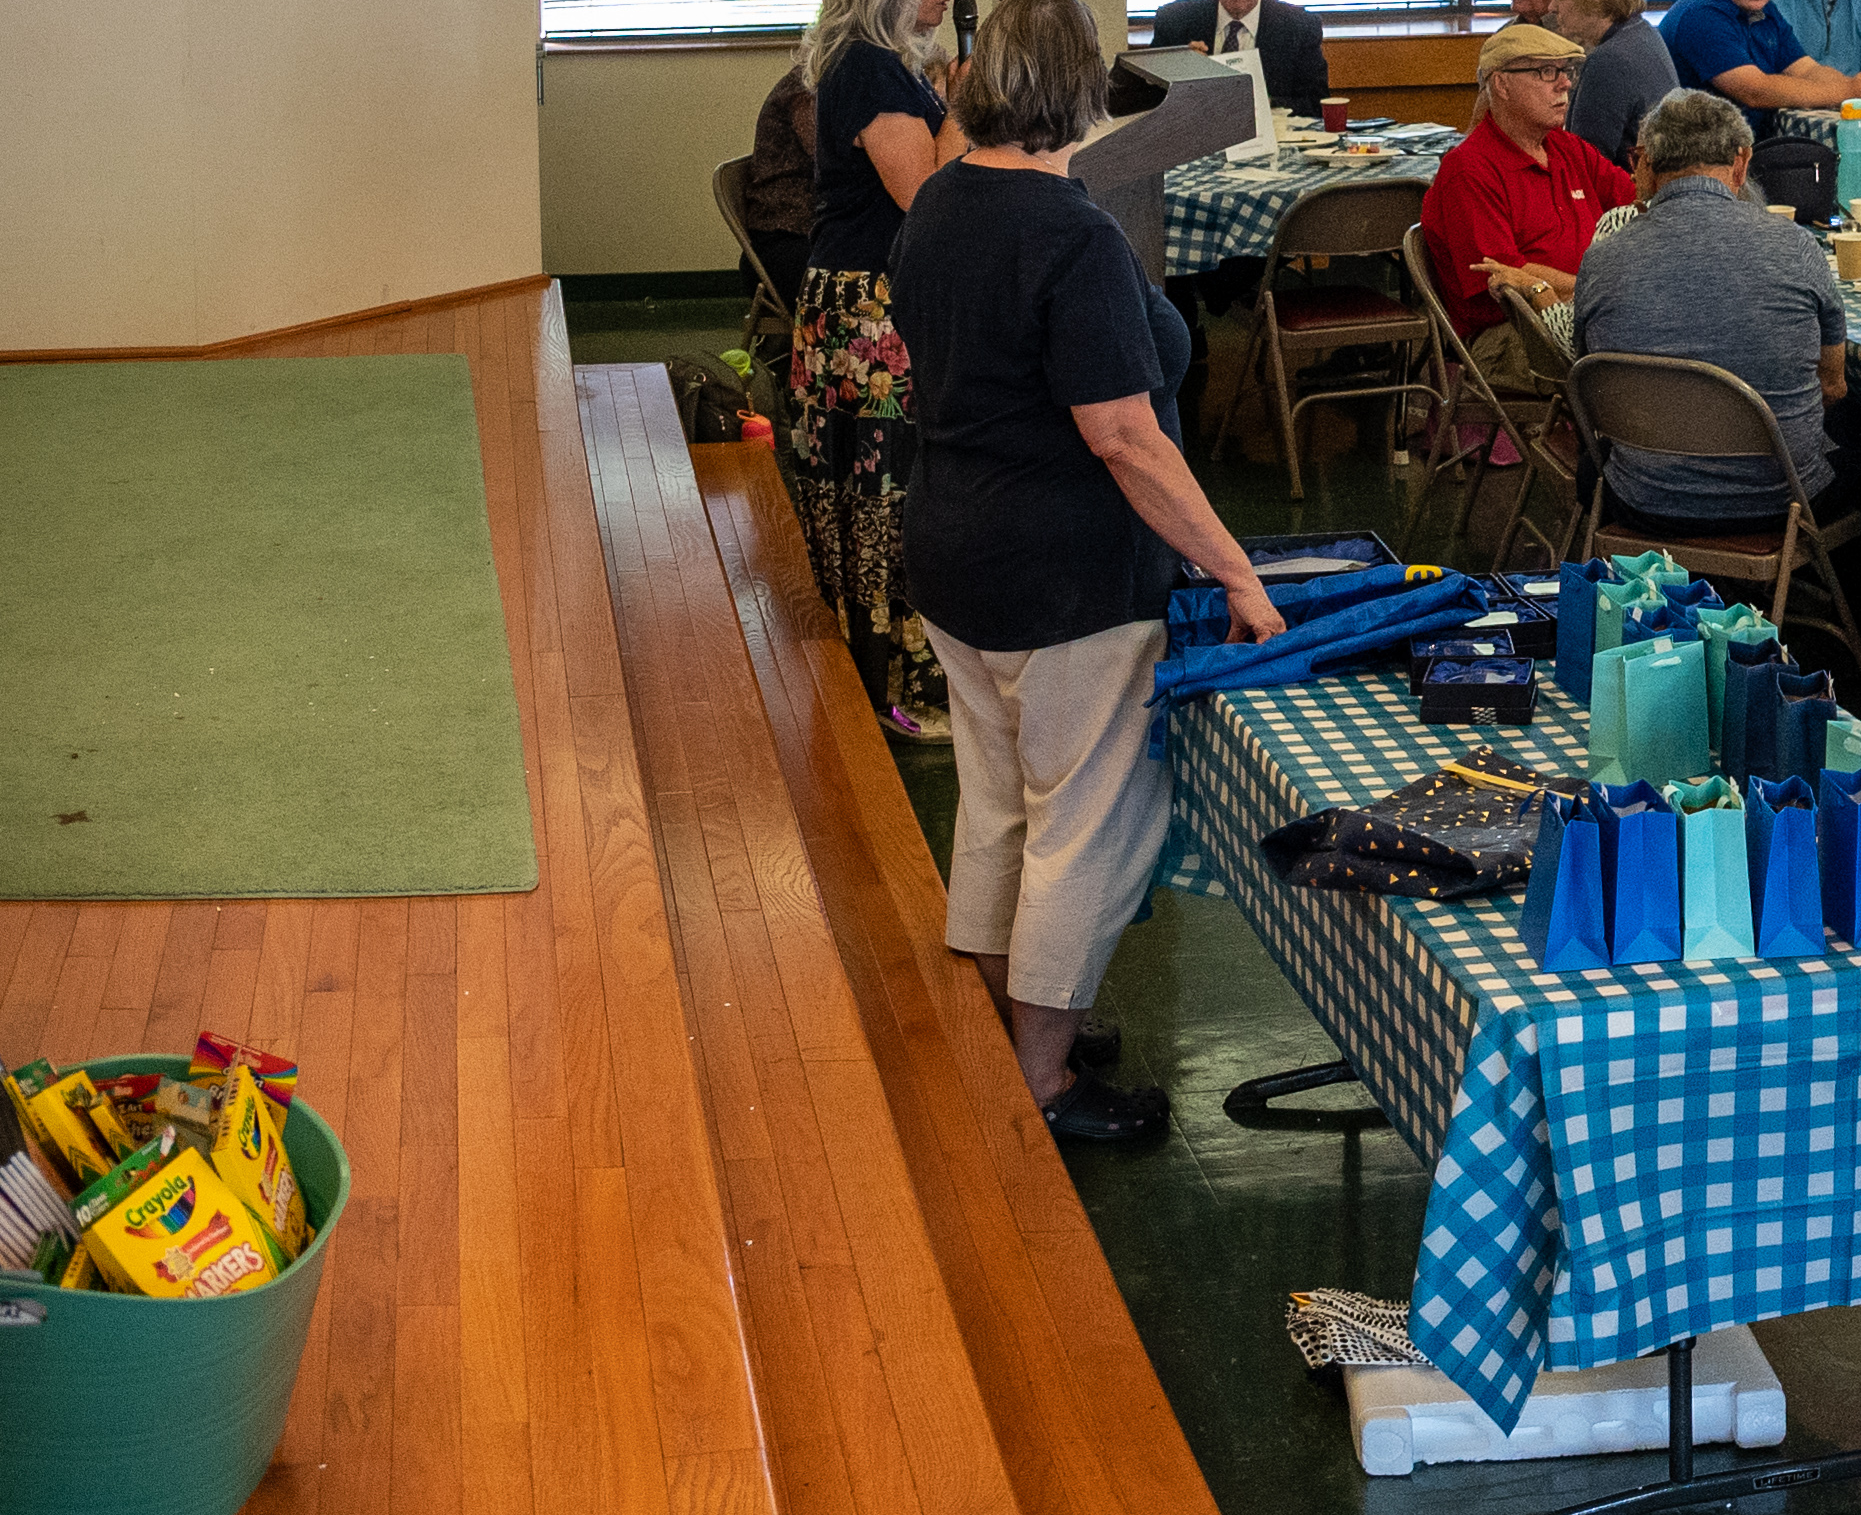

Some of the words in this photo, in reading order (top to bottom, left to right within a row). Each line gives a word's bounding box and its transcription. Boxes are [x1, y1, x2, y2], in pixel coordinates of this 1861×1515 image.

[124, 1175, 188, 1227] Crayola
[75, 1204, 92, 1228] 10
[1759, 1470, 1813, 1487] LIFETIME
